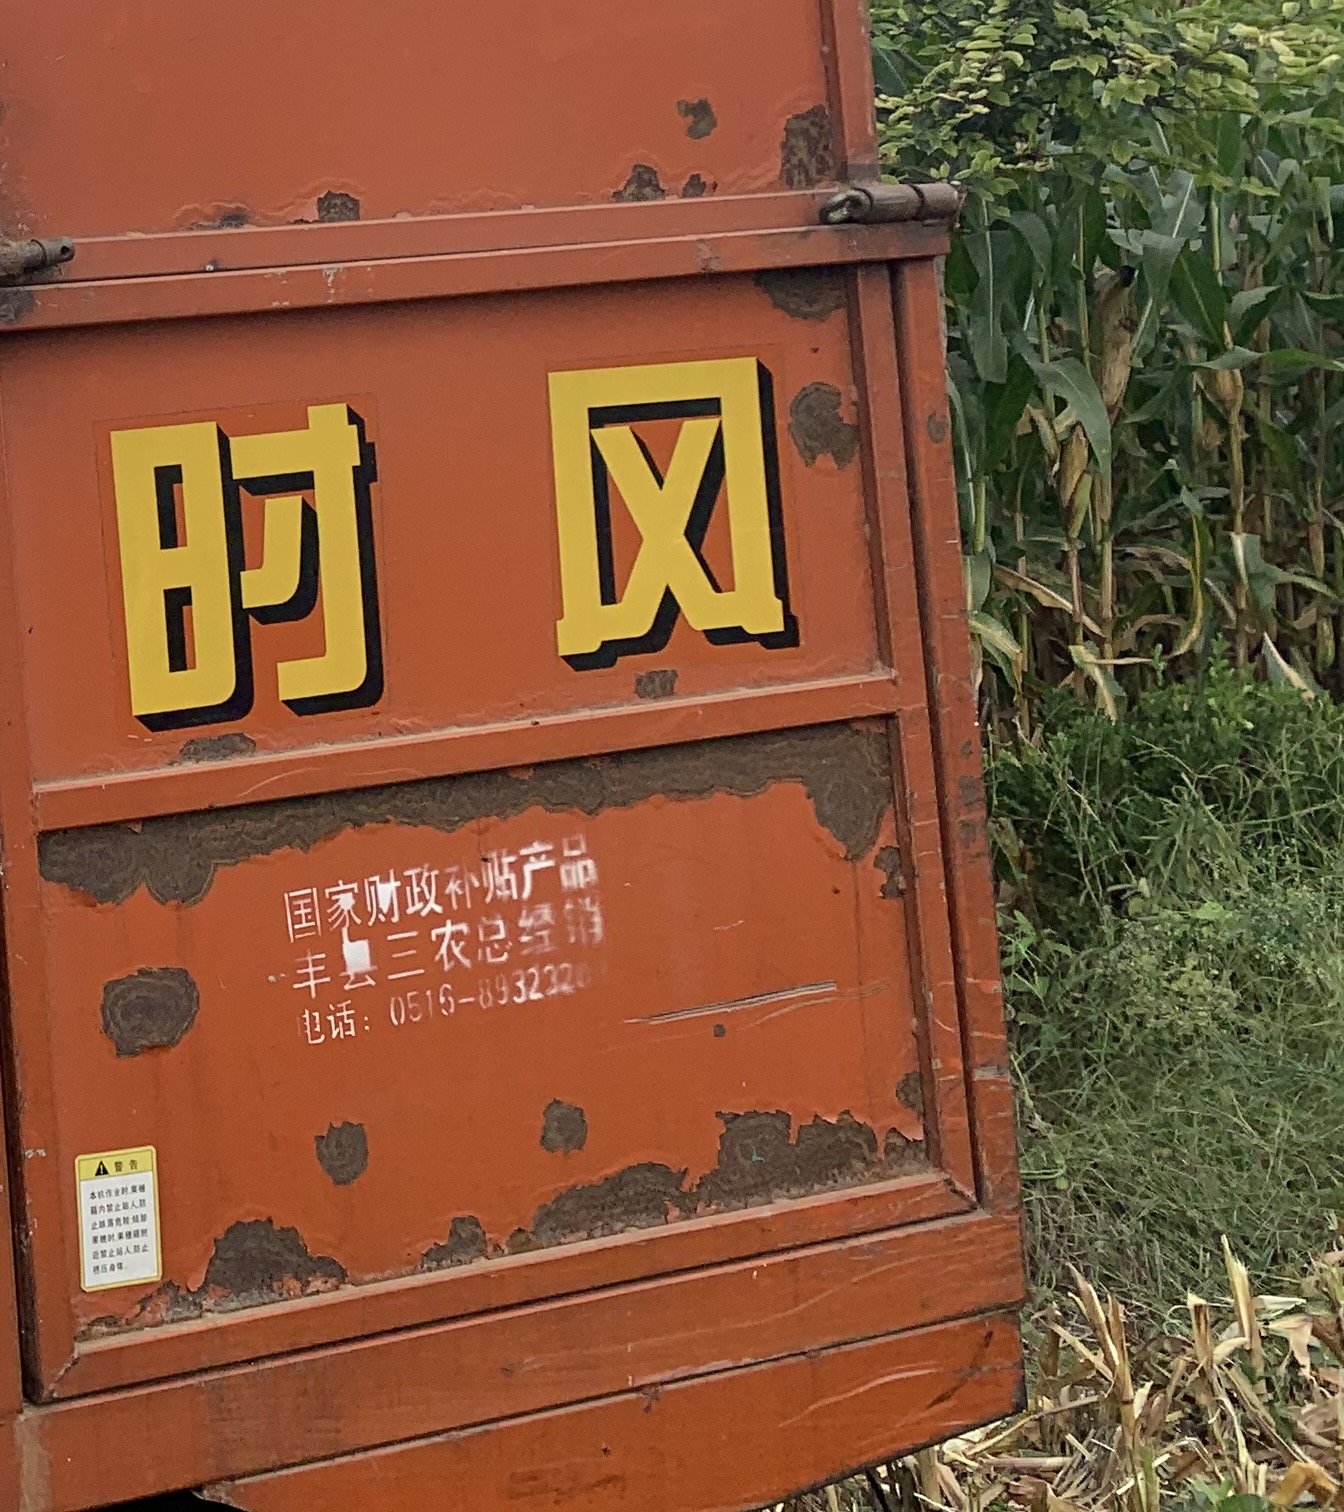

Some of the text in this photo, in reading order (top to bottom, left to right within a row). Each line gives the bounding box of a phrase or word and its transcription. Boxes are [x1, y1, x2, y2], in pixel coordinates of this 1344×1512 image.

[283, 833, 600, 944] 国家财政补贴产品
